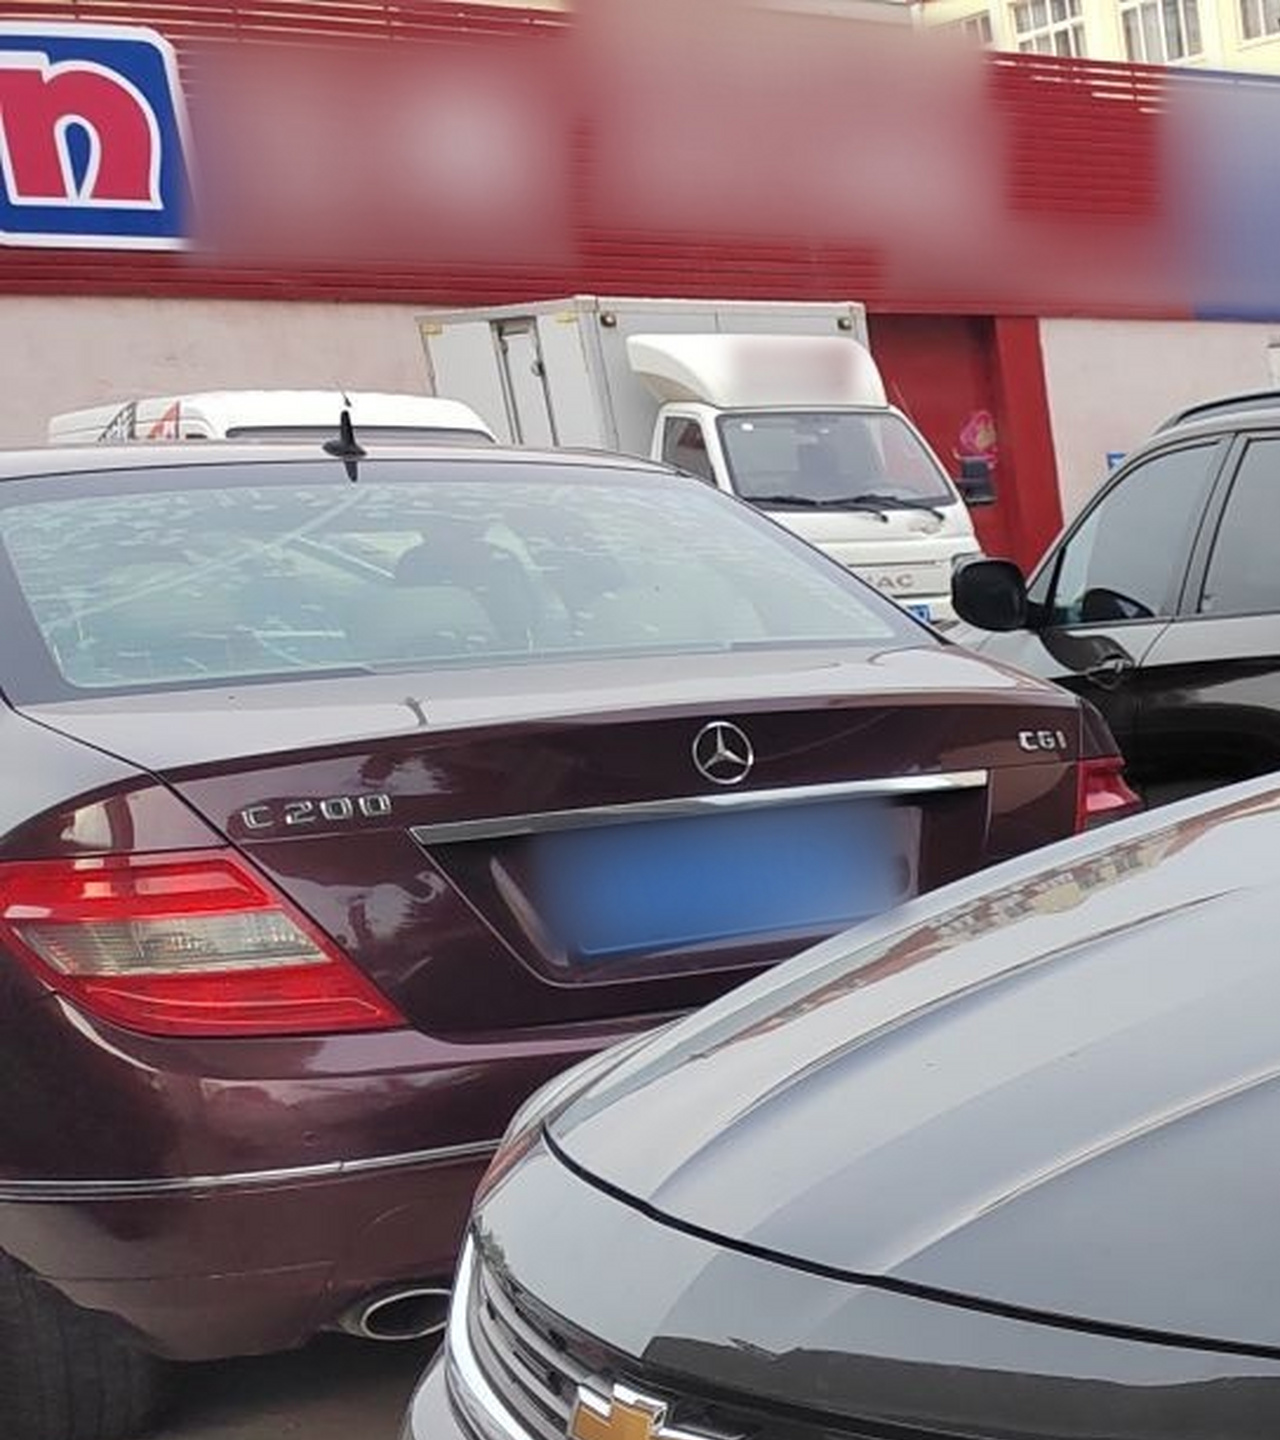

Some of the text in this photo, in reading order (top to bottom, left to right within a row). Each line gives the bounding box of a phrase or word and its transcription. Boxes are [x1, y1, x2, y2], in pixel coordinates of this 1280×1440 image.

[1018, 730, 1067, 751] CGI
[242, 794, 392, 829] C 200
